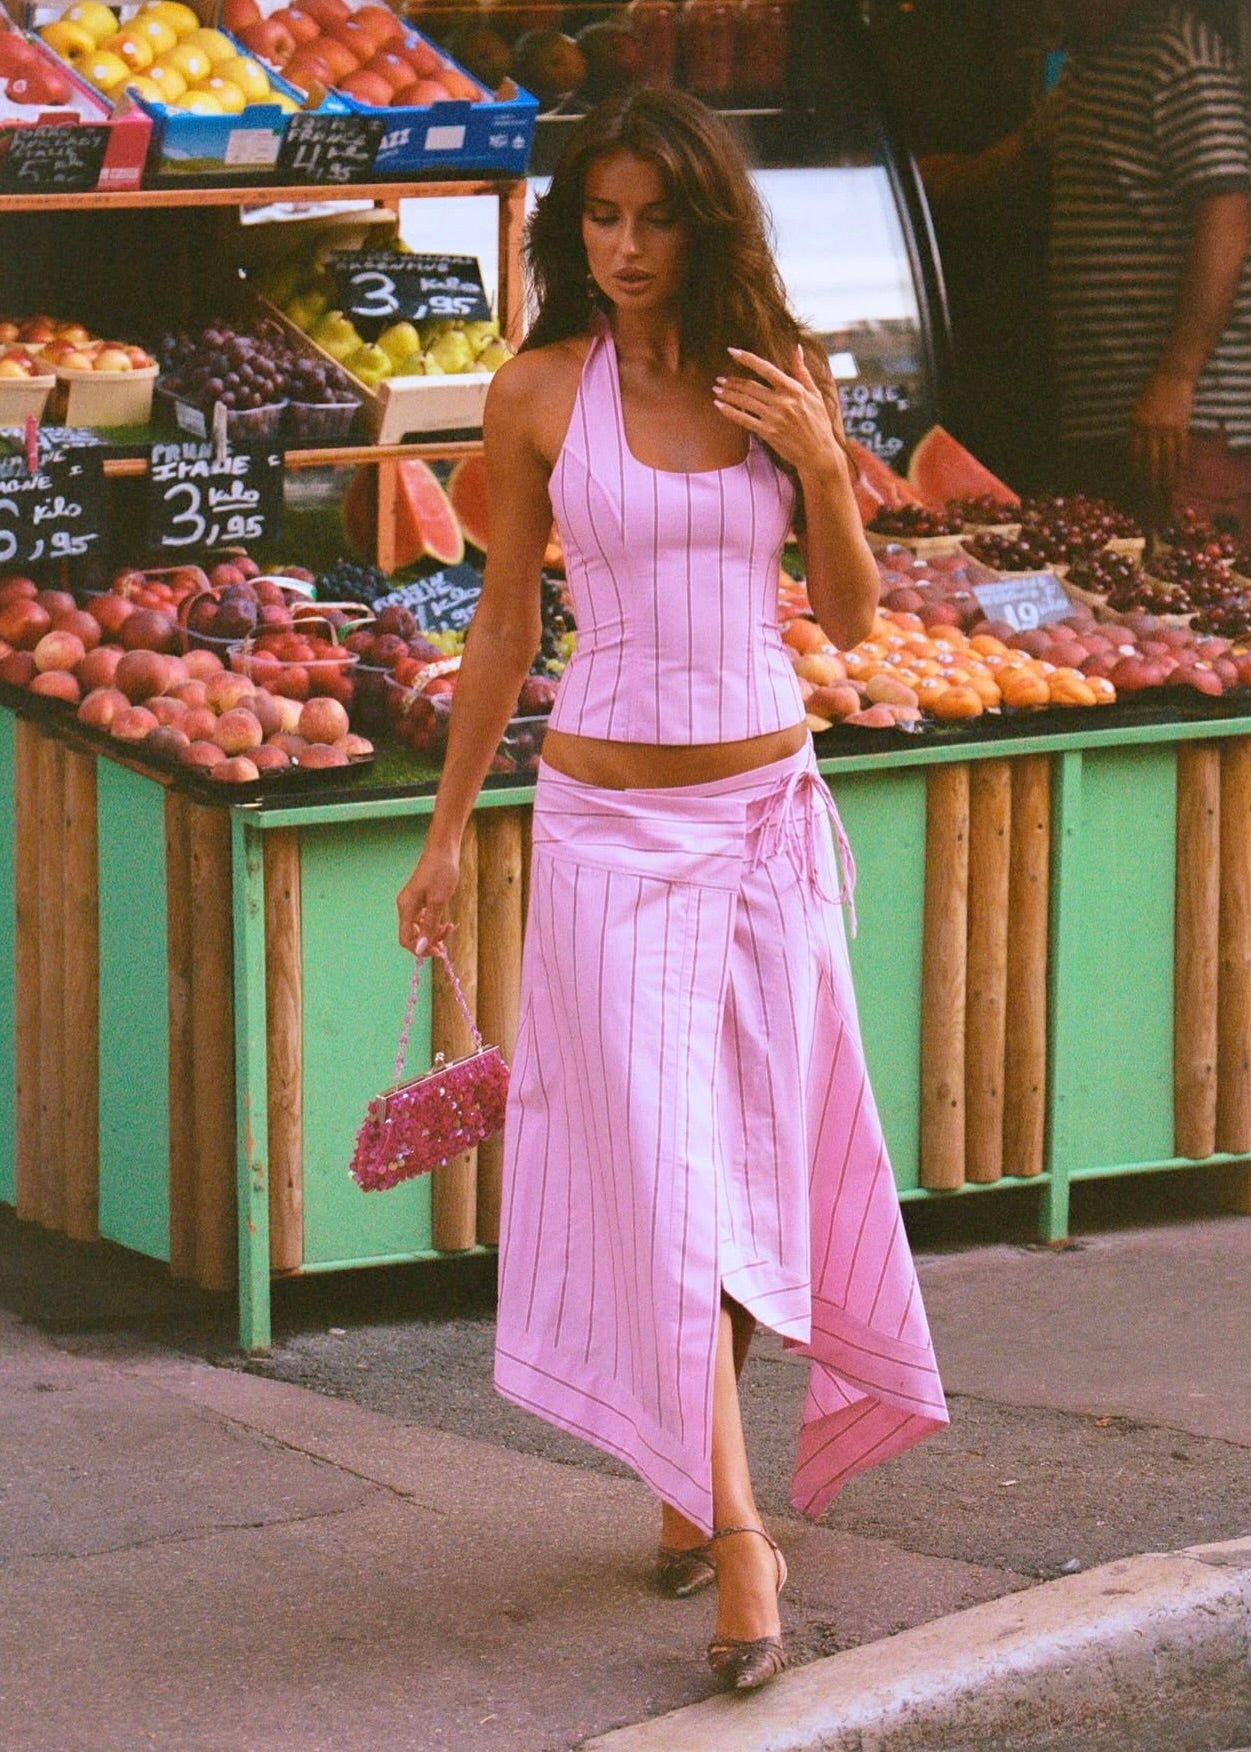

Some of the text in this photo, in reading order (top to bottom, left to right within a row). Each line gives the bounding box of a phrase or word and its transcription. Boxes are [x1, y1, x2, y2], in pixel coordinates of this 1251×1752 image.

[378, 128, 411, 151] AZZ
[209, 480, 261, 507] kilo
[33, 496, 83, 525] kilo
